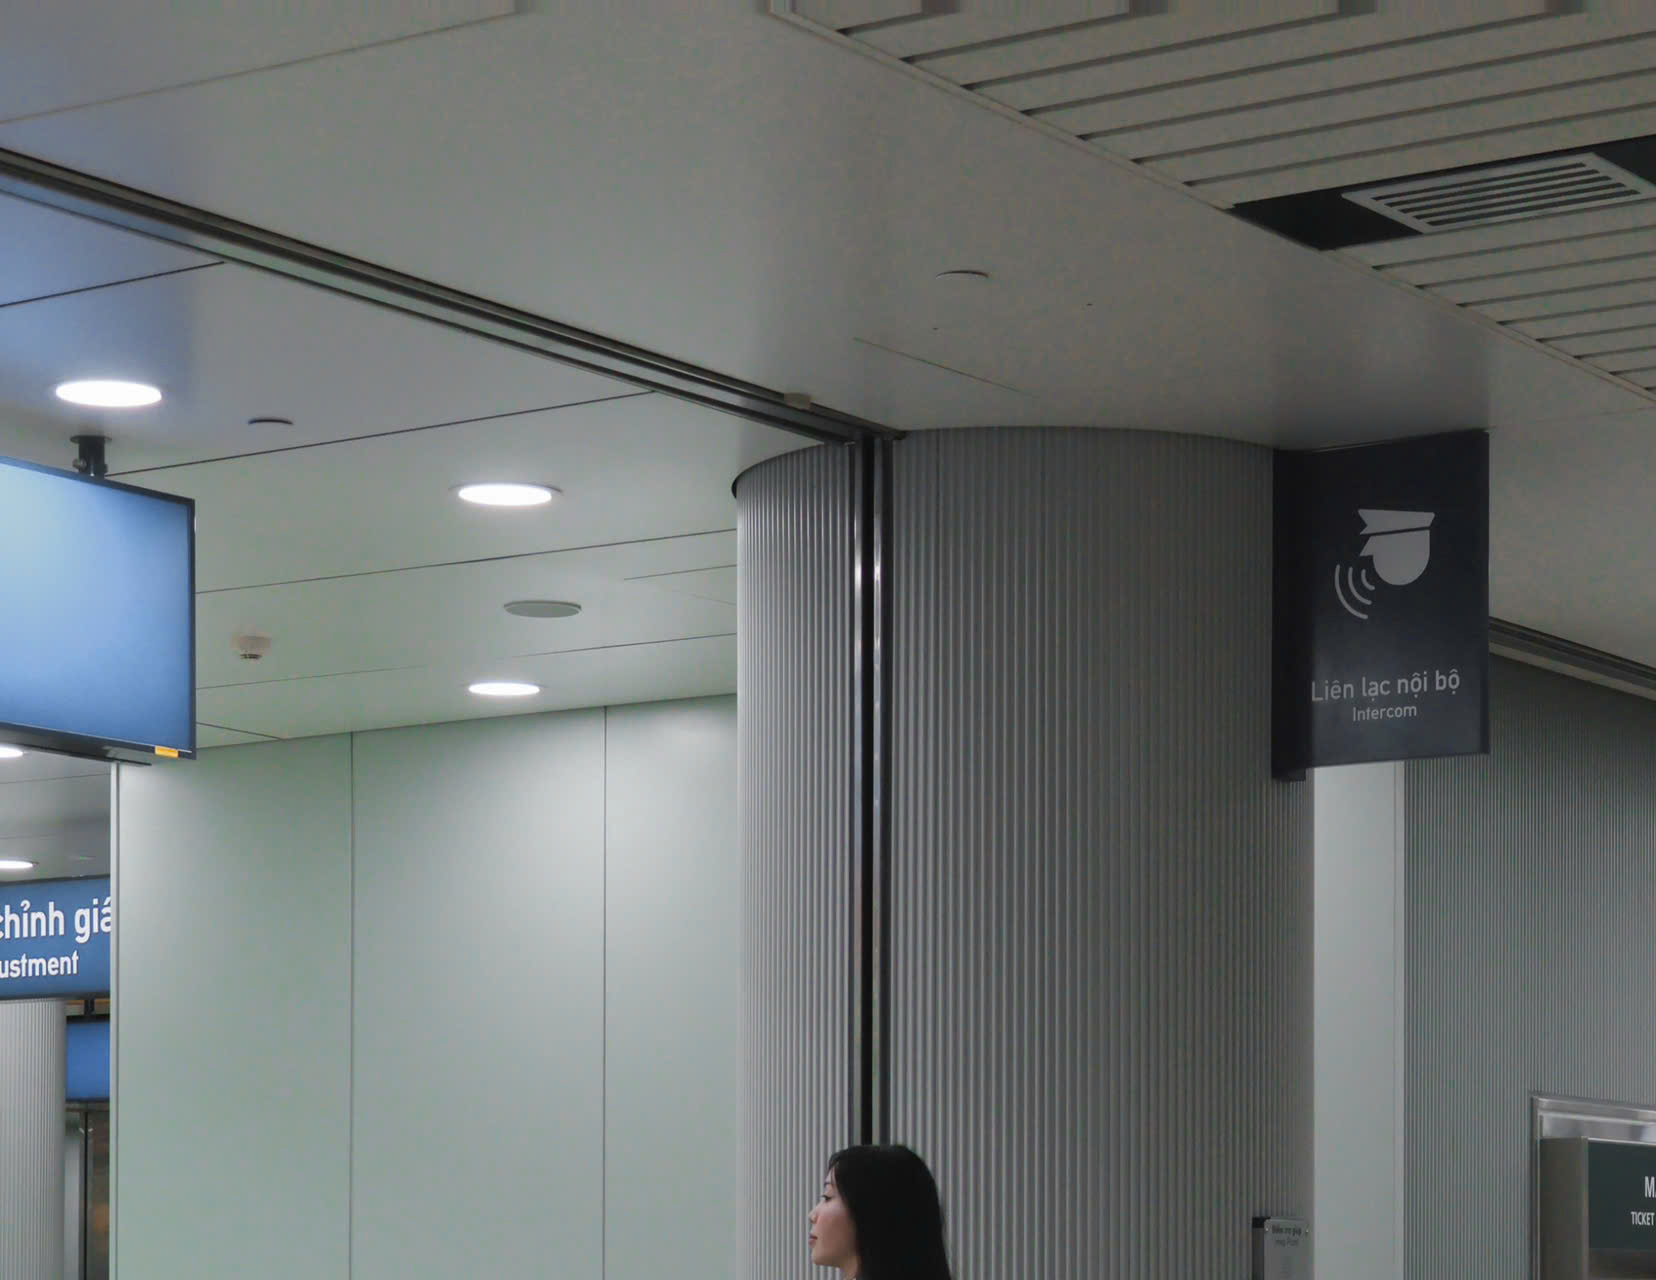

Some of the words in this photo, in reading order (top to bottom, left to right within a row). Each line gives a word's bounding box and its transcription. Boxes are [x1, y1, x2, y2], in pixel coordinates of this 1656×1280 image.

[1311, 680, 1354, 702] Liên
[1362, 676, 1391, 702] lạc
[1397, 671, 1428, 698] nội
[1435, 668, 1461, 695] bộ
[1352, 705, 1418, 722] Intercom
[74, 895, 112, 944] giá
[1630, 1211, 1655, 1226] TICKET
